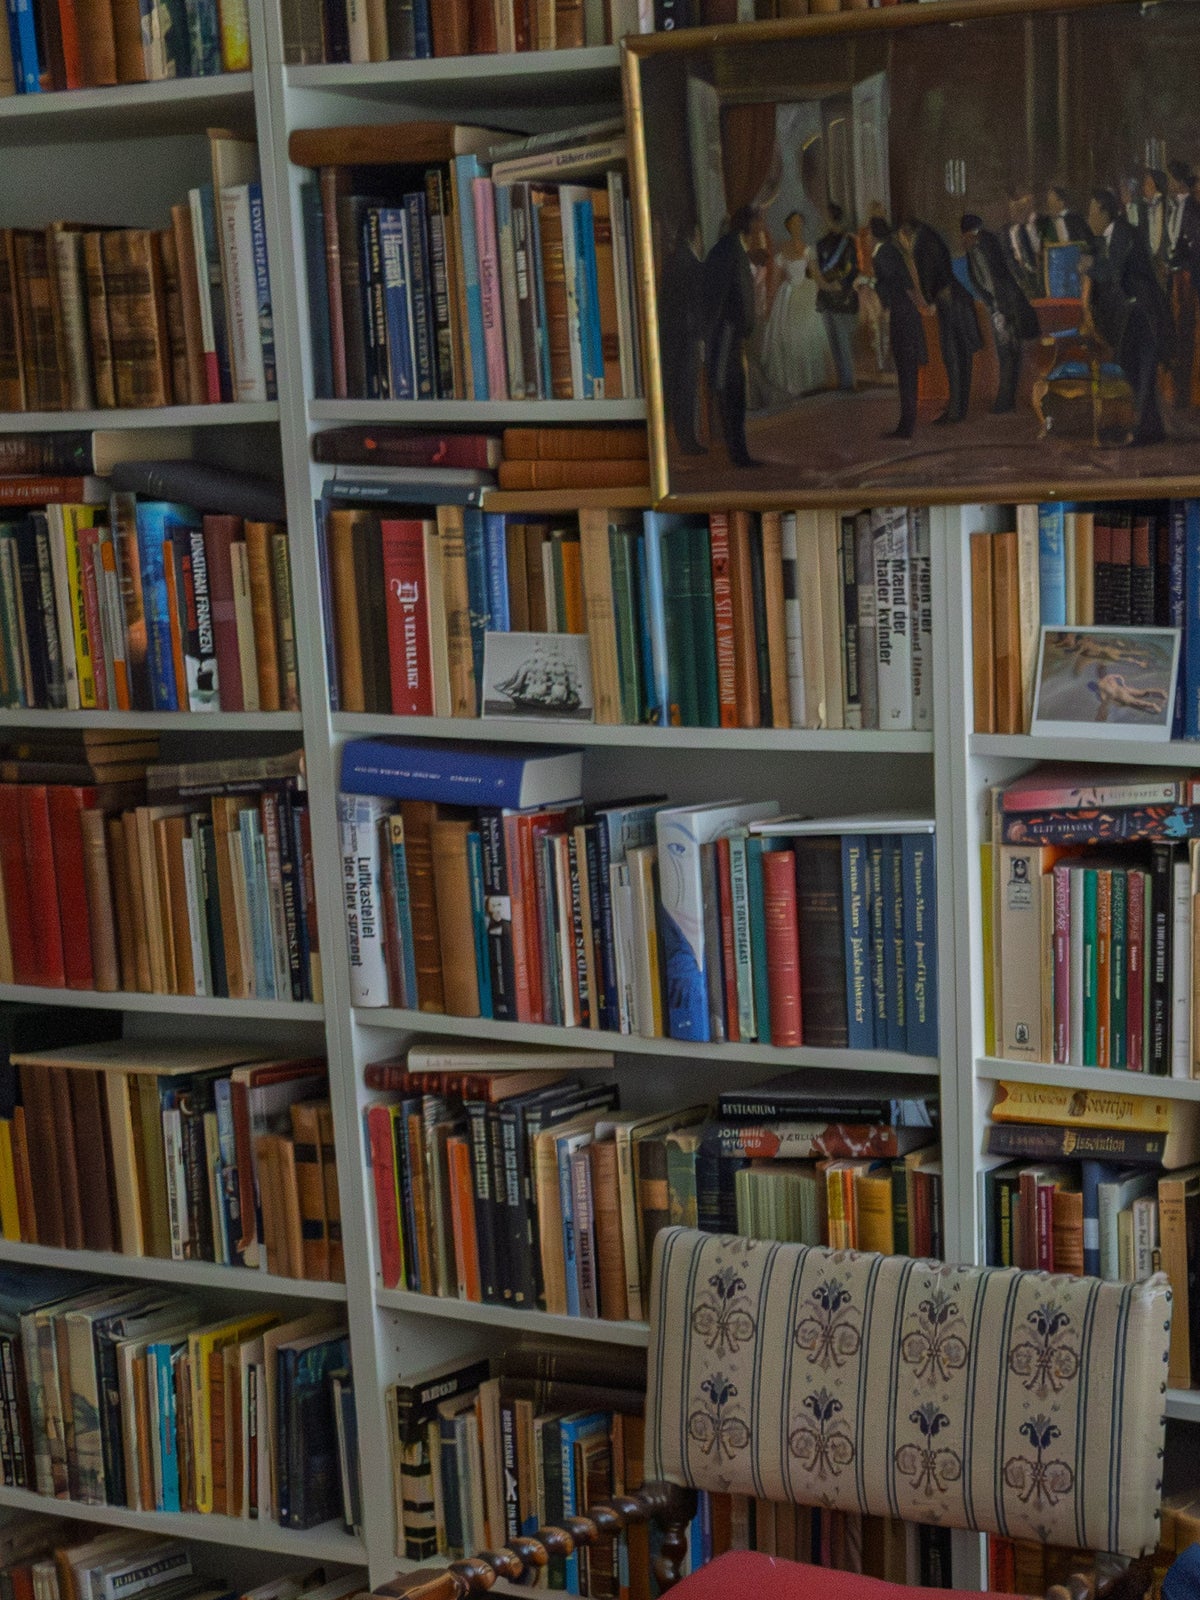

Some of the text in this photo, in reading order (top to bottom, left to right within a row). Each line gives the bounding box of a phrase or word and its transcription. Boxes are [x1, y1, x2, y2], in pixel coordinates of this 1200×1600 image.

[190, 532, 214, 653] JONATHAN FRANZEN
[717, 622, 733, 632] A
[877, 559, 892, 666] hader kvinder
[891, 559, 907, 637] Mænd der
[921, 608, 932, 635] der
[357, 856, 375, 939] Luftkastellet
[733, 850, 743, 874] BILLY
[850, 847, 861, 928] Thomas Mann
[914, 850, 925, 932] Thomas Mann
[343, 856, 362, 967] der blev sprængt
[874, 895, 884, 928] Mann
[717, 1127, 765, 1138] JOHANNE
[722, 1103, 776, 1115] BESTIARIUM
